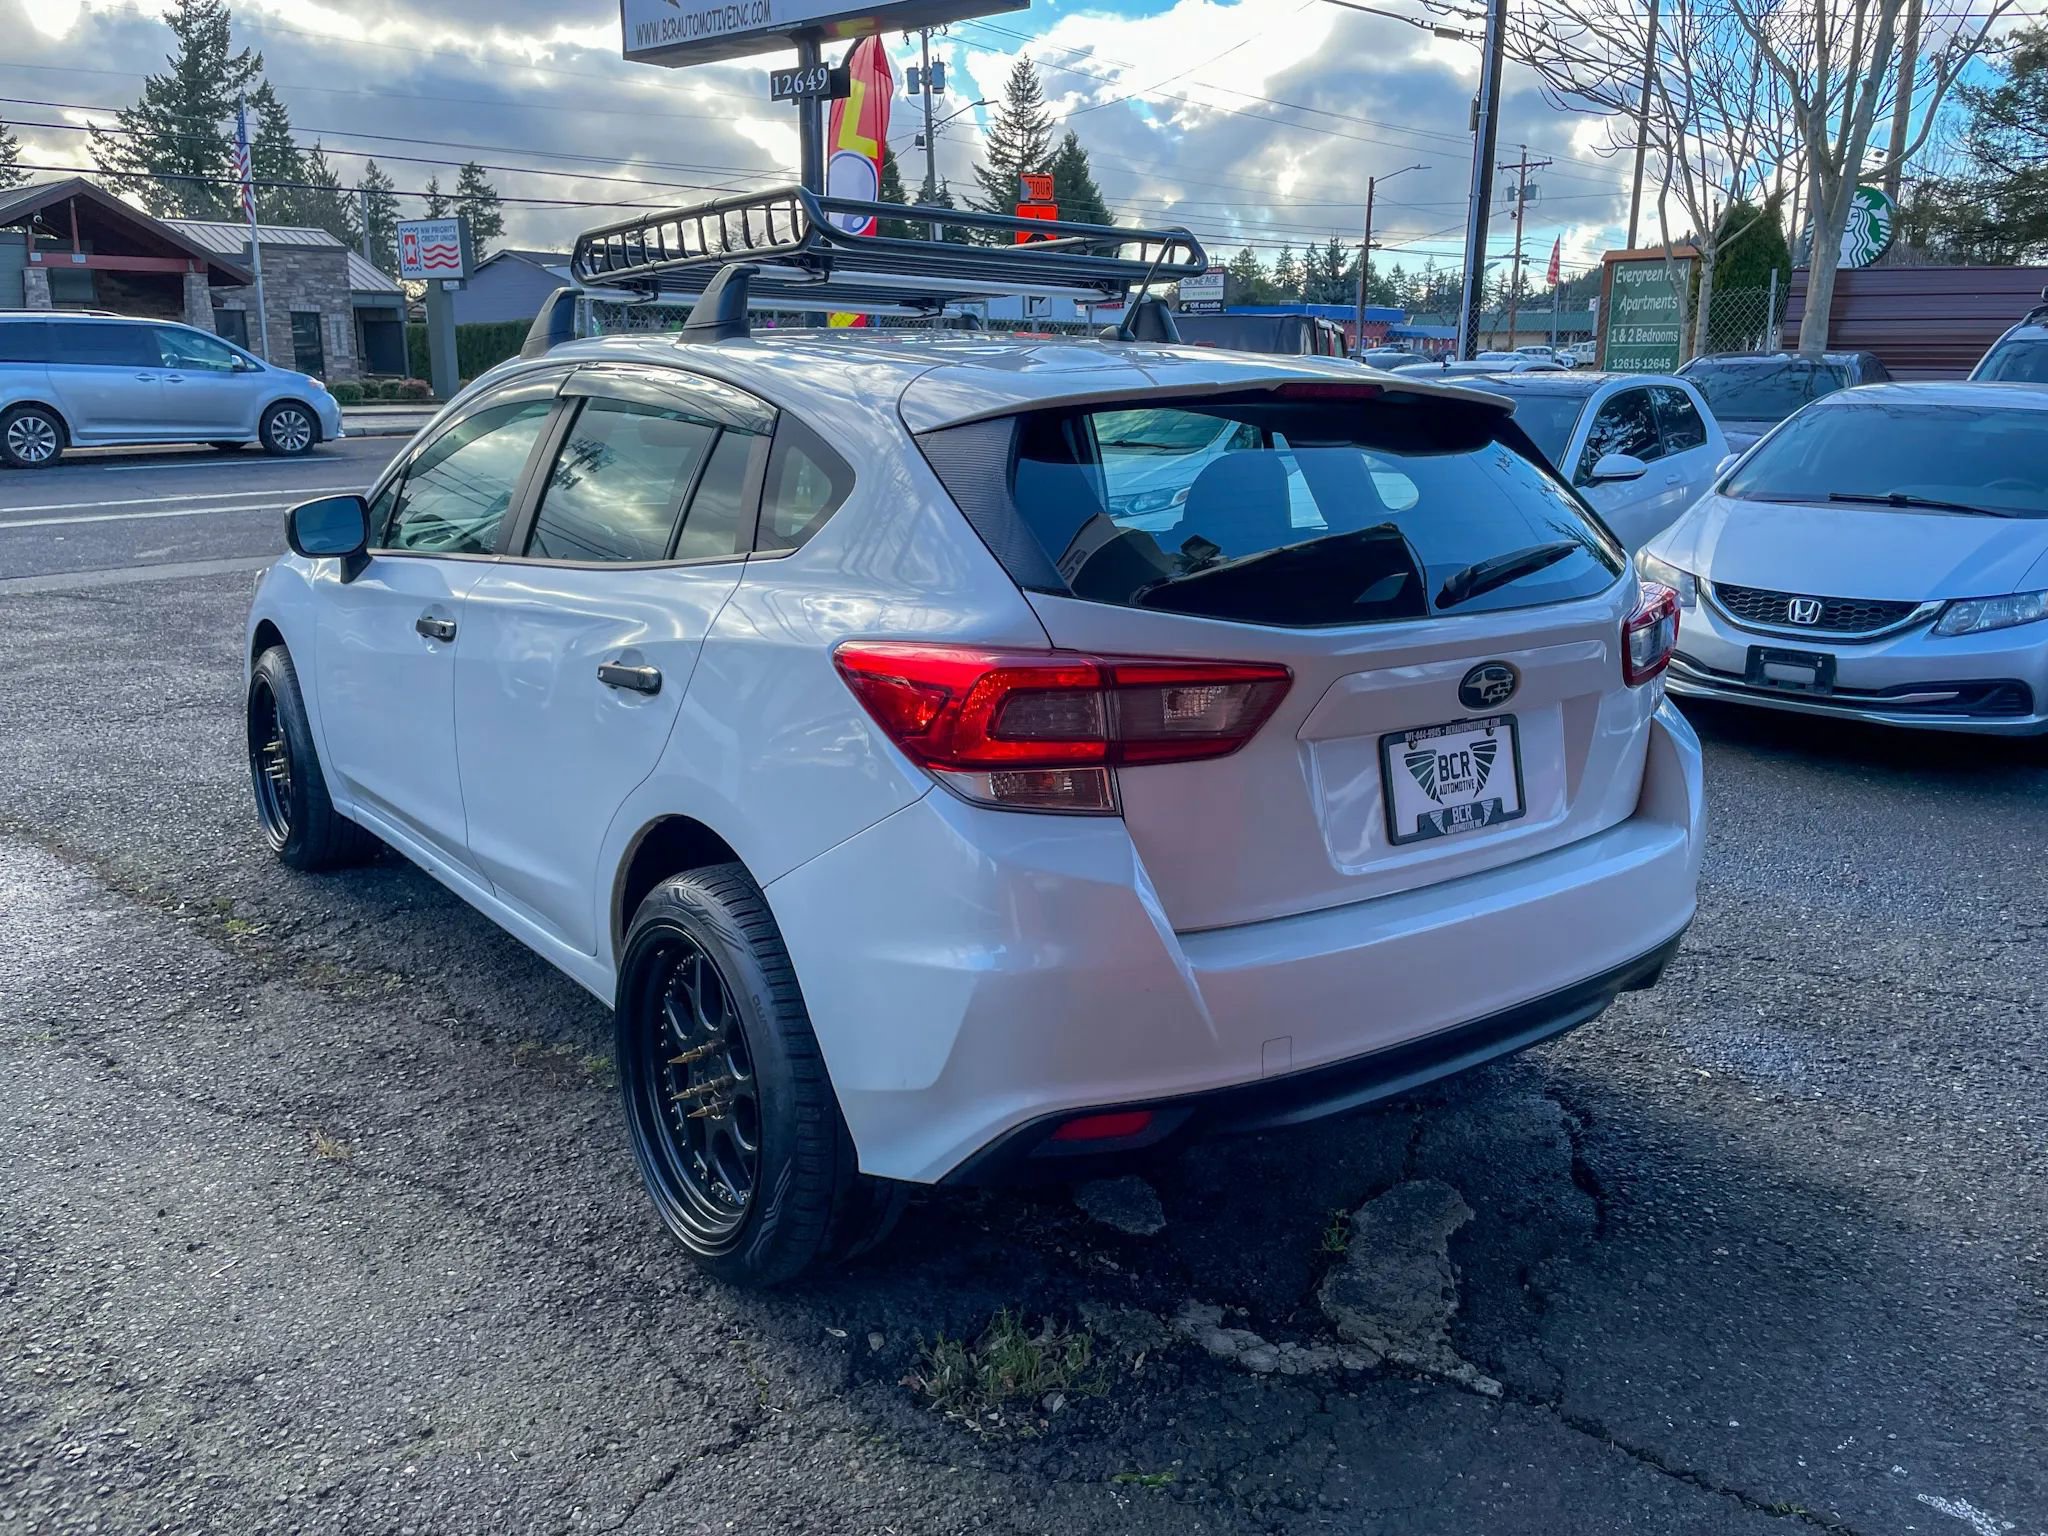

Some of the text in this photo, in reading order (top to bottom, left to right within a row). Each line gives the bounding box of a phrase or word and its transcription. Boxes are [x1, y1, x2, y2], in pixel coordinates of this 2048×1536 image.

[636, 0, 772, 46] WWW.BCRAUTOMOTIVEINC.COM
[773, 67, 828, 96] 12649
[421, 234, 438, 242] CREDIT
[431, 225, 456, 234] PRIORITY
[1615, 265, 1664, 287] Evergreen
[1619, 294, 1678, 315] Apartments
[1611, 327, 1678, 343] 1 & 2 Bedrooms
[1612, 358, 1671, 369] 12615-12645
[1438, 751, 1472, 782] BCR
[1439, 779, 1475, 796] AUTOMOTIVE
[1451, 804, 1473, 822] BCR
